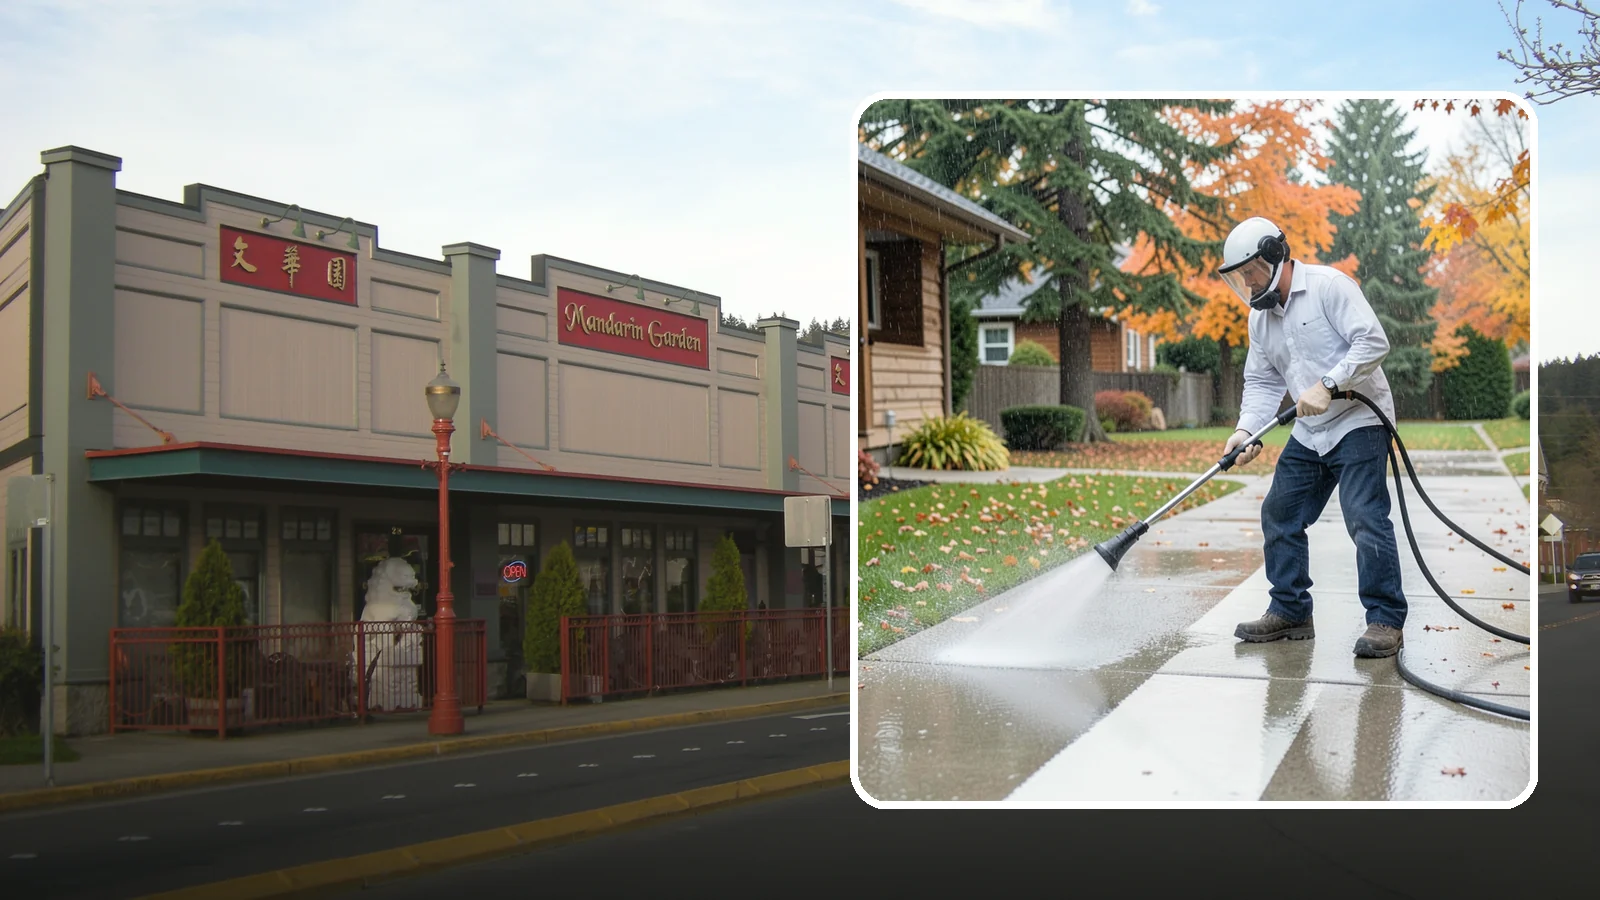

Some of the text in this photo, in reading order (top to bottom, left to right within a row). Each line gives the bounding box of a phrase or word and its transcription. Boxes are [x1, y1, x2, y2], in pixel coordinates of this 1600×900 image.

[231, 236, 346, 291] 文華園
[564, 302, 701, 352] Mandarin Garden
[503, 565, 527, 578] OPEN
